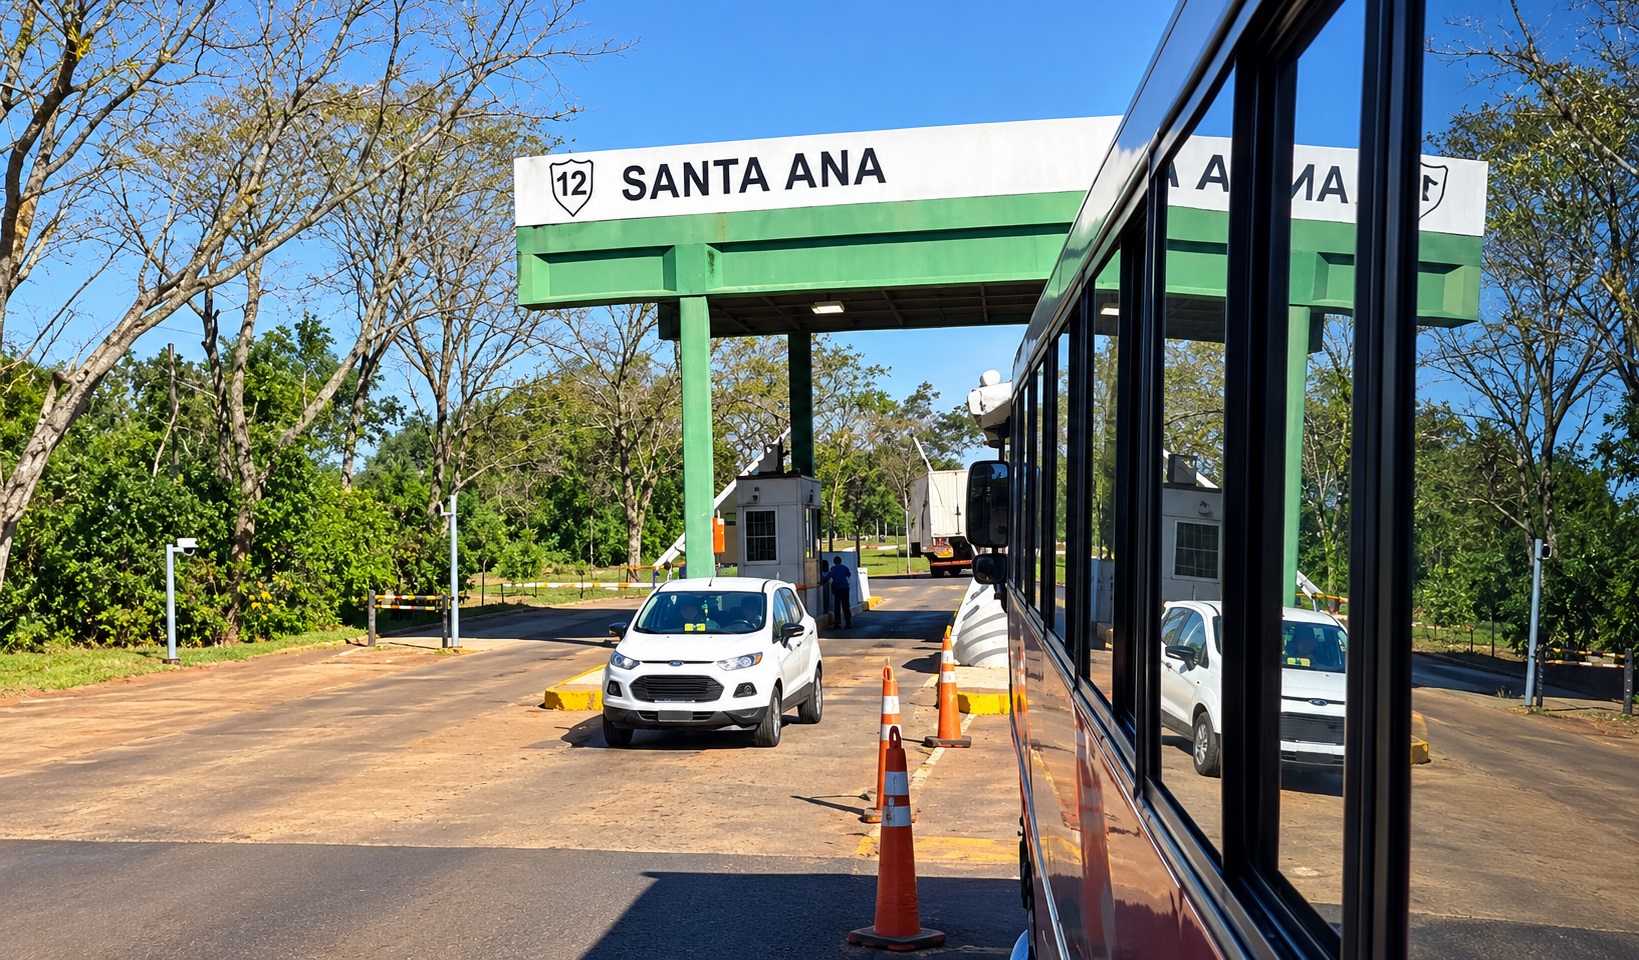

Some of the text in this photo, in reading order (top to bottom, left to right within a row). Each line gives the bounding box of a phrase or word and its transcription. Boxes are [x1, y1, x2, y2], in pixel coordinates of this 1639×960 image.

[556, 170, 587, 197] 12
[622, 147, 887, 201] SANTA ANA
